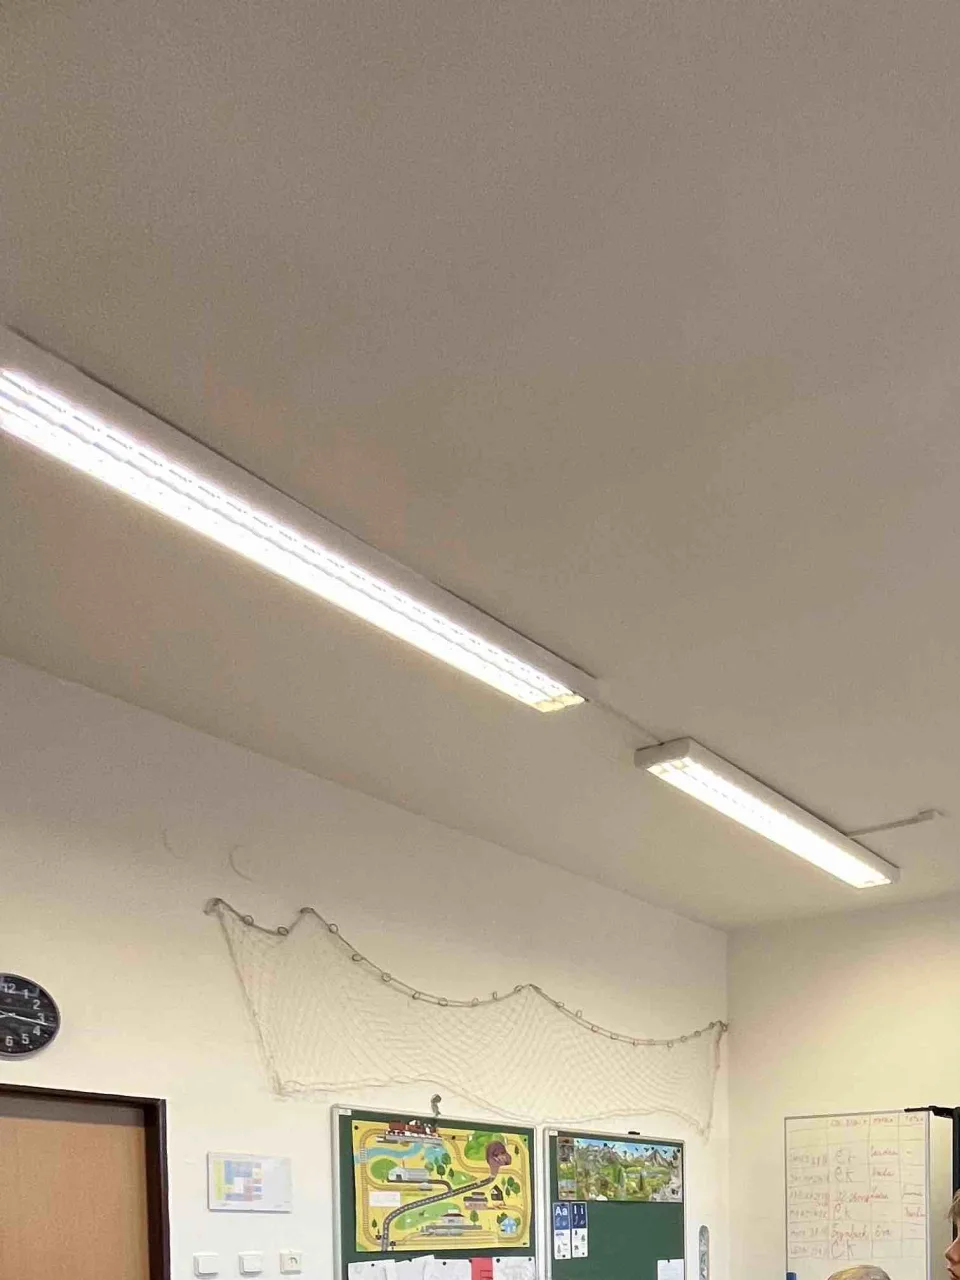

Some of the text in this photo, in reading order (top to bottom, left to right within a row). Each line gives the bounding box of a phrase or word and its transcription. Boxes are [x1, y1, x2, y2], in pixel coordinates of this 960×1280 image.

[22, 988, 29, 999] 1
[33, 999, 41, 1010] 2
[37, 1012, 45, 1023] 3
[32, 1025, 41, 1036] 4
[5, 1035, 14, 1047] 6
[21, 1034, 30, 1045] 5
[555, 1205, 568, 1216] Aa
